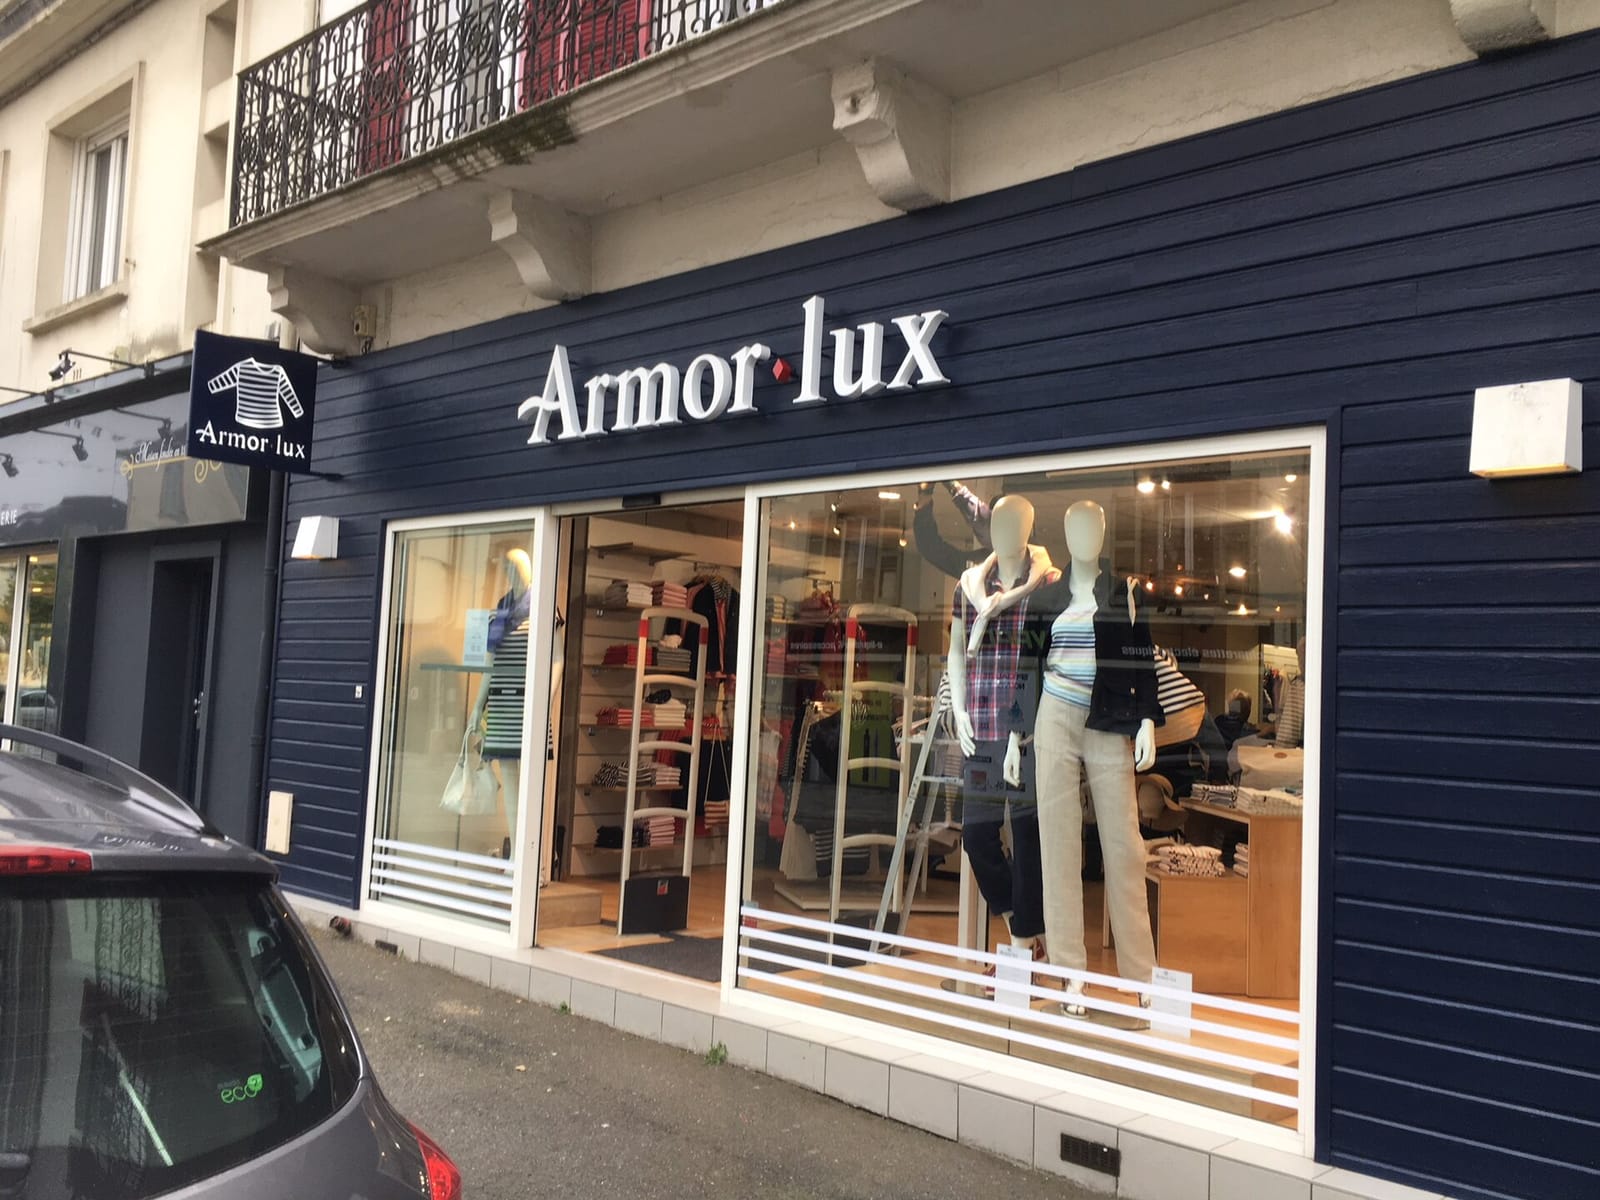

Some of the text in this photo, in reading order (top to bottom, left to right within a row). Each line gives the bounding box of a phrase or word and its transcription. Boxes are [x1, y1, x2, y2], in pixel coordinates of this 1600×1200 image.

[517, 294, 951, 444] Armor lux
[195, 419, 269, 452] Armor
[276, 434, 305, 459] lux
